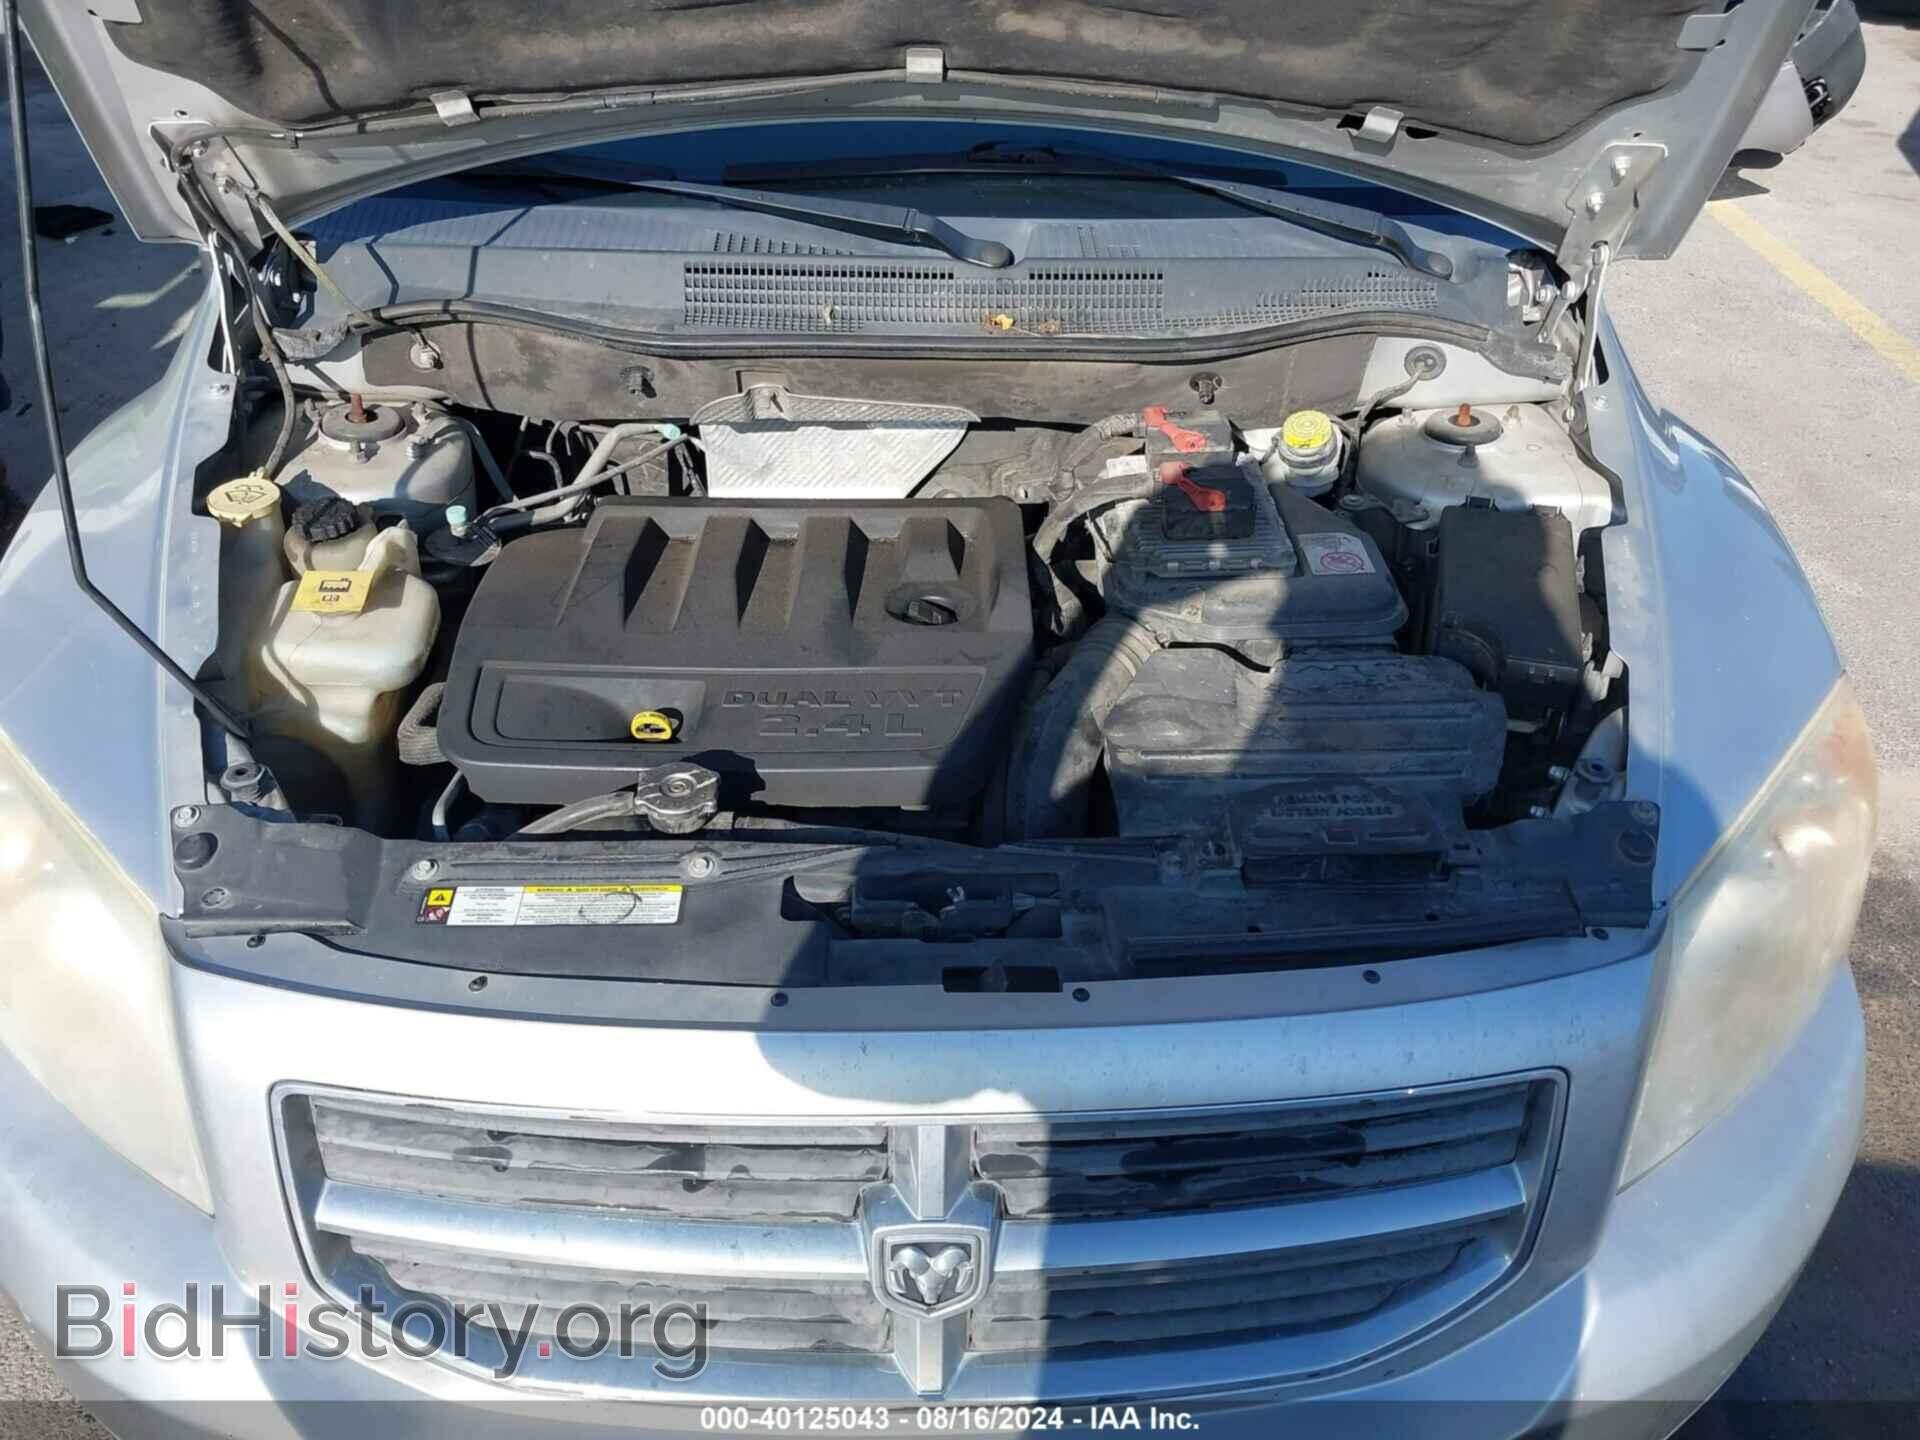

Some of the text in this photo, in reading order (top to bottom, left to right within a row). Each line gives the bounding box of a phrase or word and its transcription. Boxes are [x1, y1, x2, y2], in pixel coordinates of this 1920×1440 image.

[721, 688, 964, 708] DUAL VVT
[759, 712, 924, 737] 2.4L
